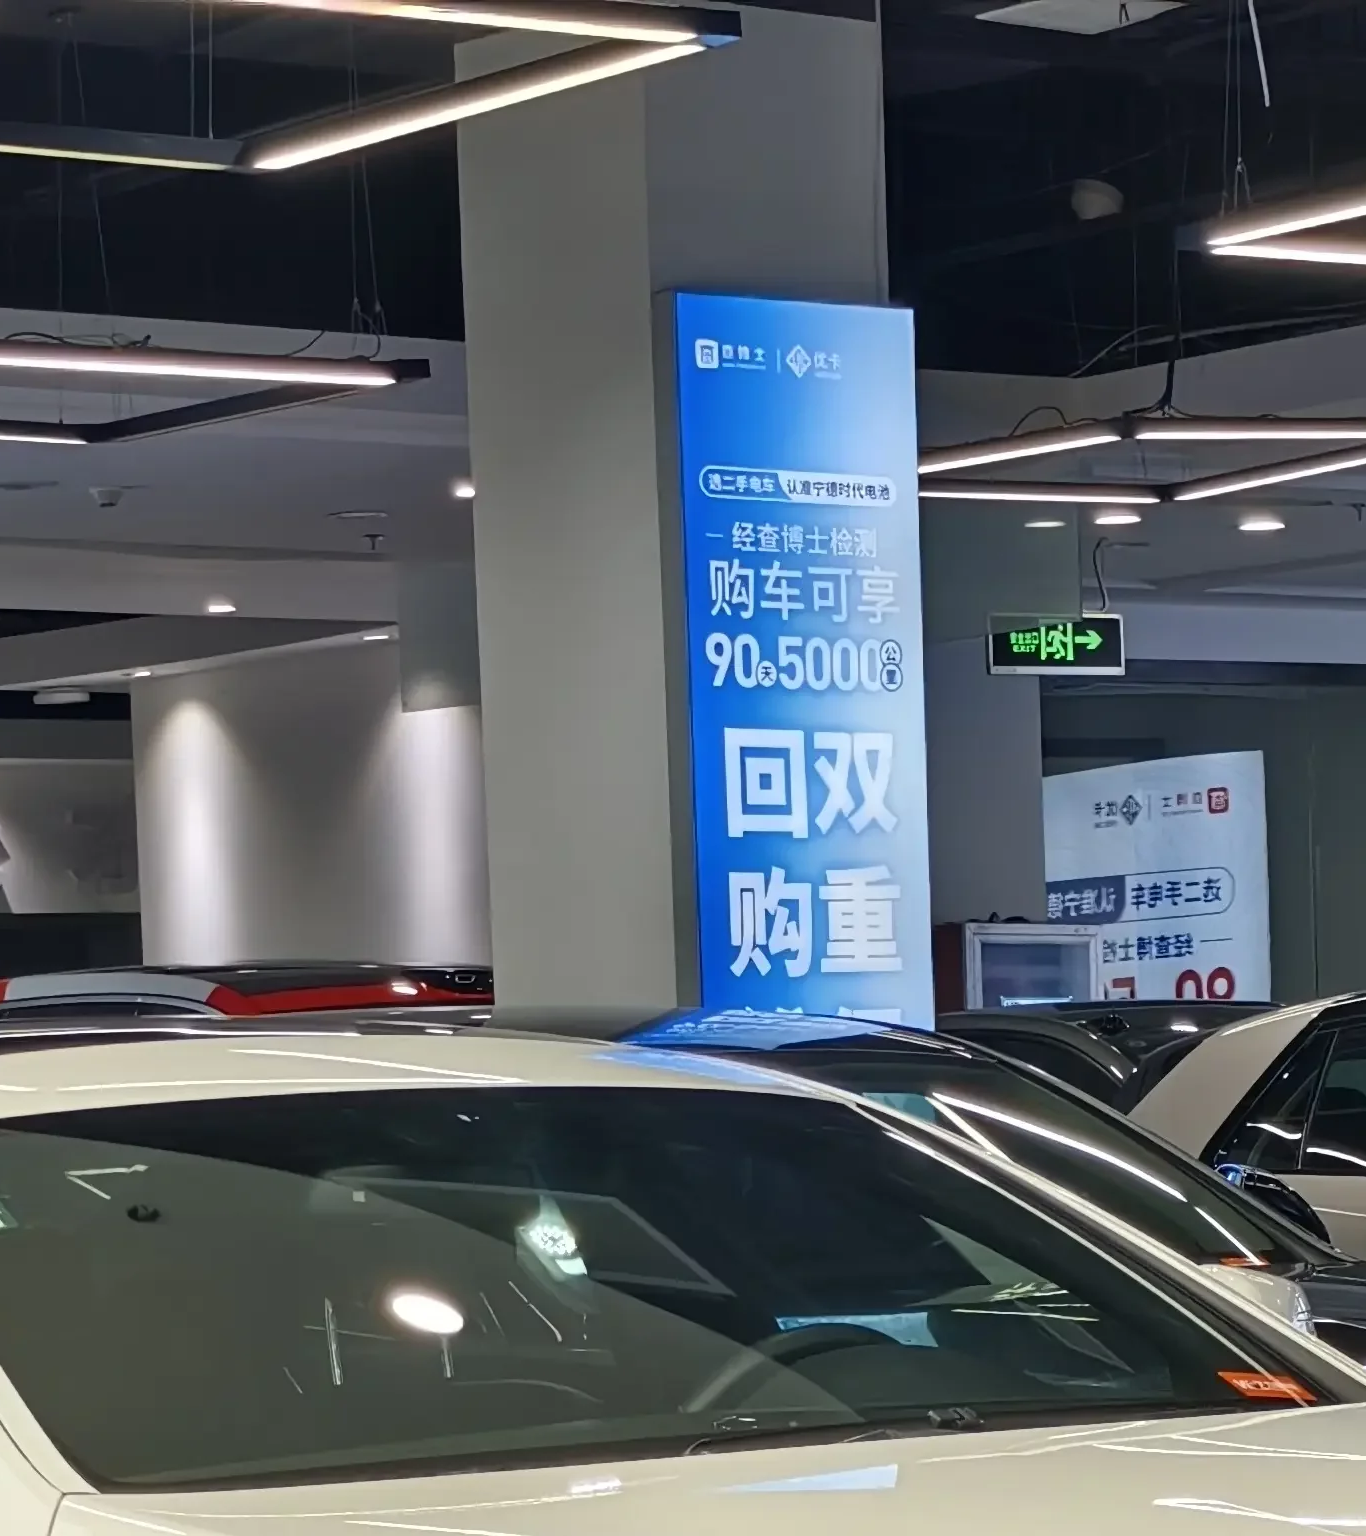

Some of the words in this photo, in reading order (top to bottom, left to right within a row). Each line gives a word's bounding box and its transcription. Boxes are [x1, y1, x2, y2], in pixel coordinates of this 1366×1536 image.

[731, 520, 878, 558] 经查博士检测
[709, 558, 901, 624] 购车可享
